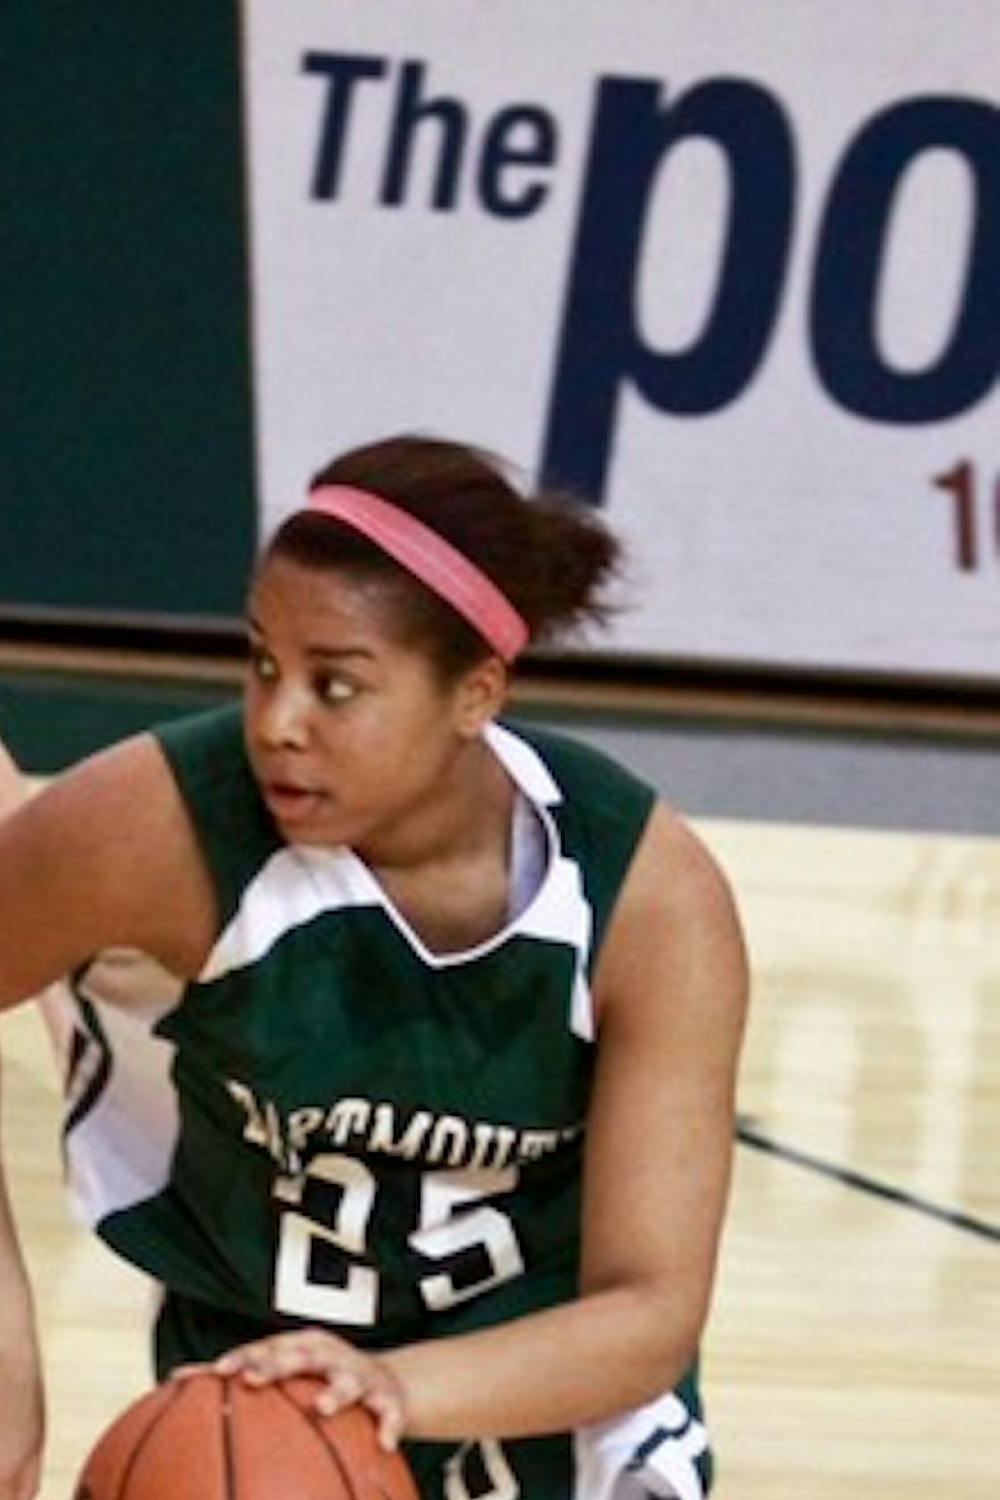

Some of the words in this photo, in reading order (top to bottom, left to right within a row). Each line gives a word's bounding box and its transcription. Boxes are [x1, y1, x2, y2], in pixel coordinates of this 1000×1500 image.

[301, 50, 559, 221] The
[537, 74, 1000, 508] po
[931, 458, 1000, 574] 1
[272, 1153, 525, 1325] 25
